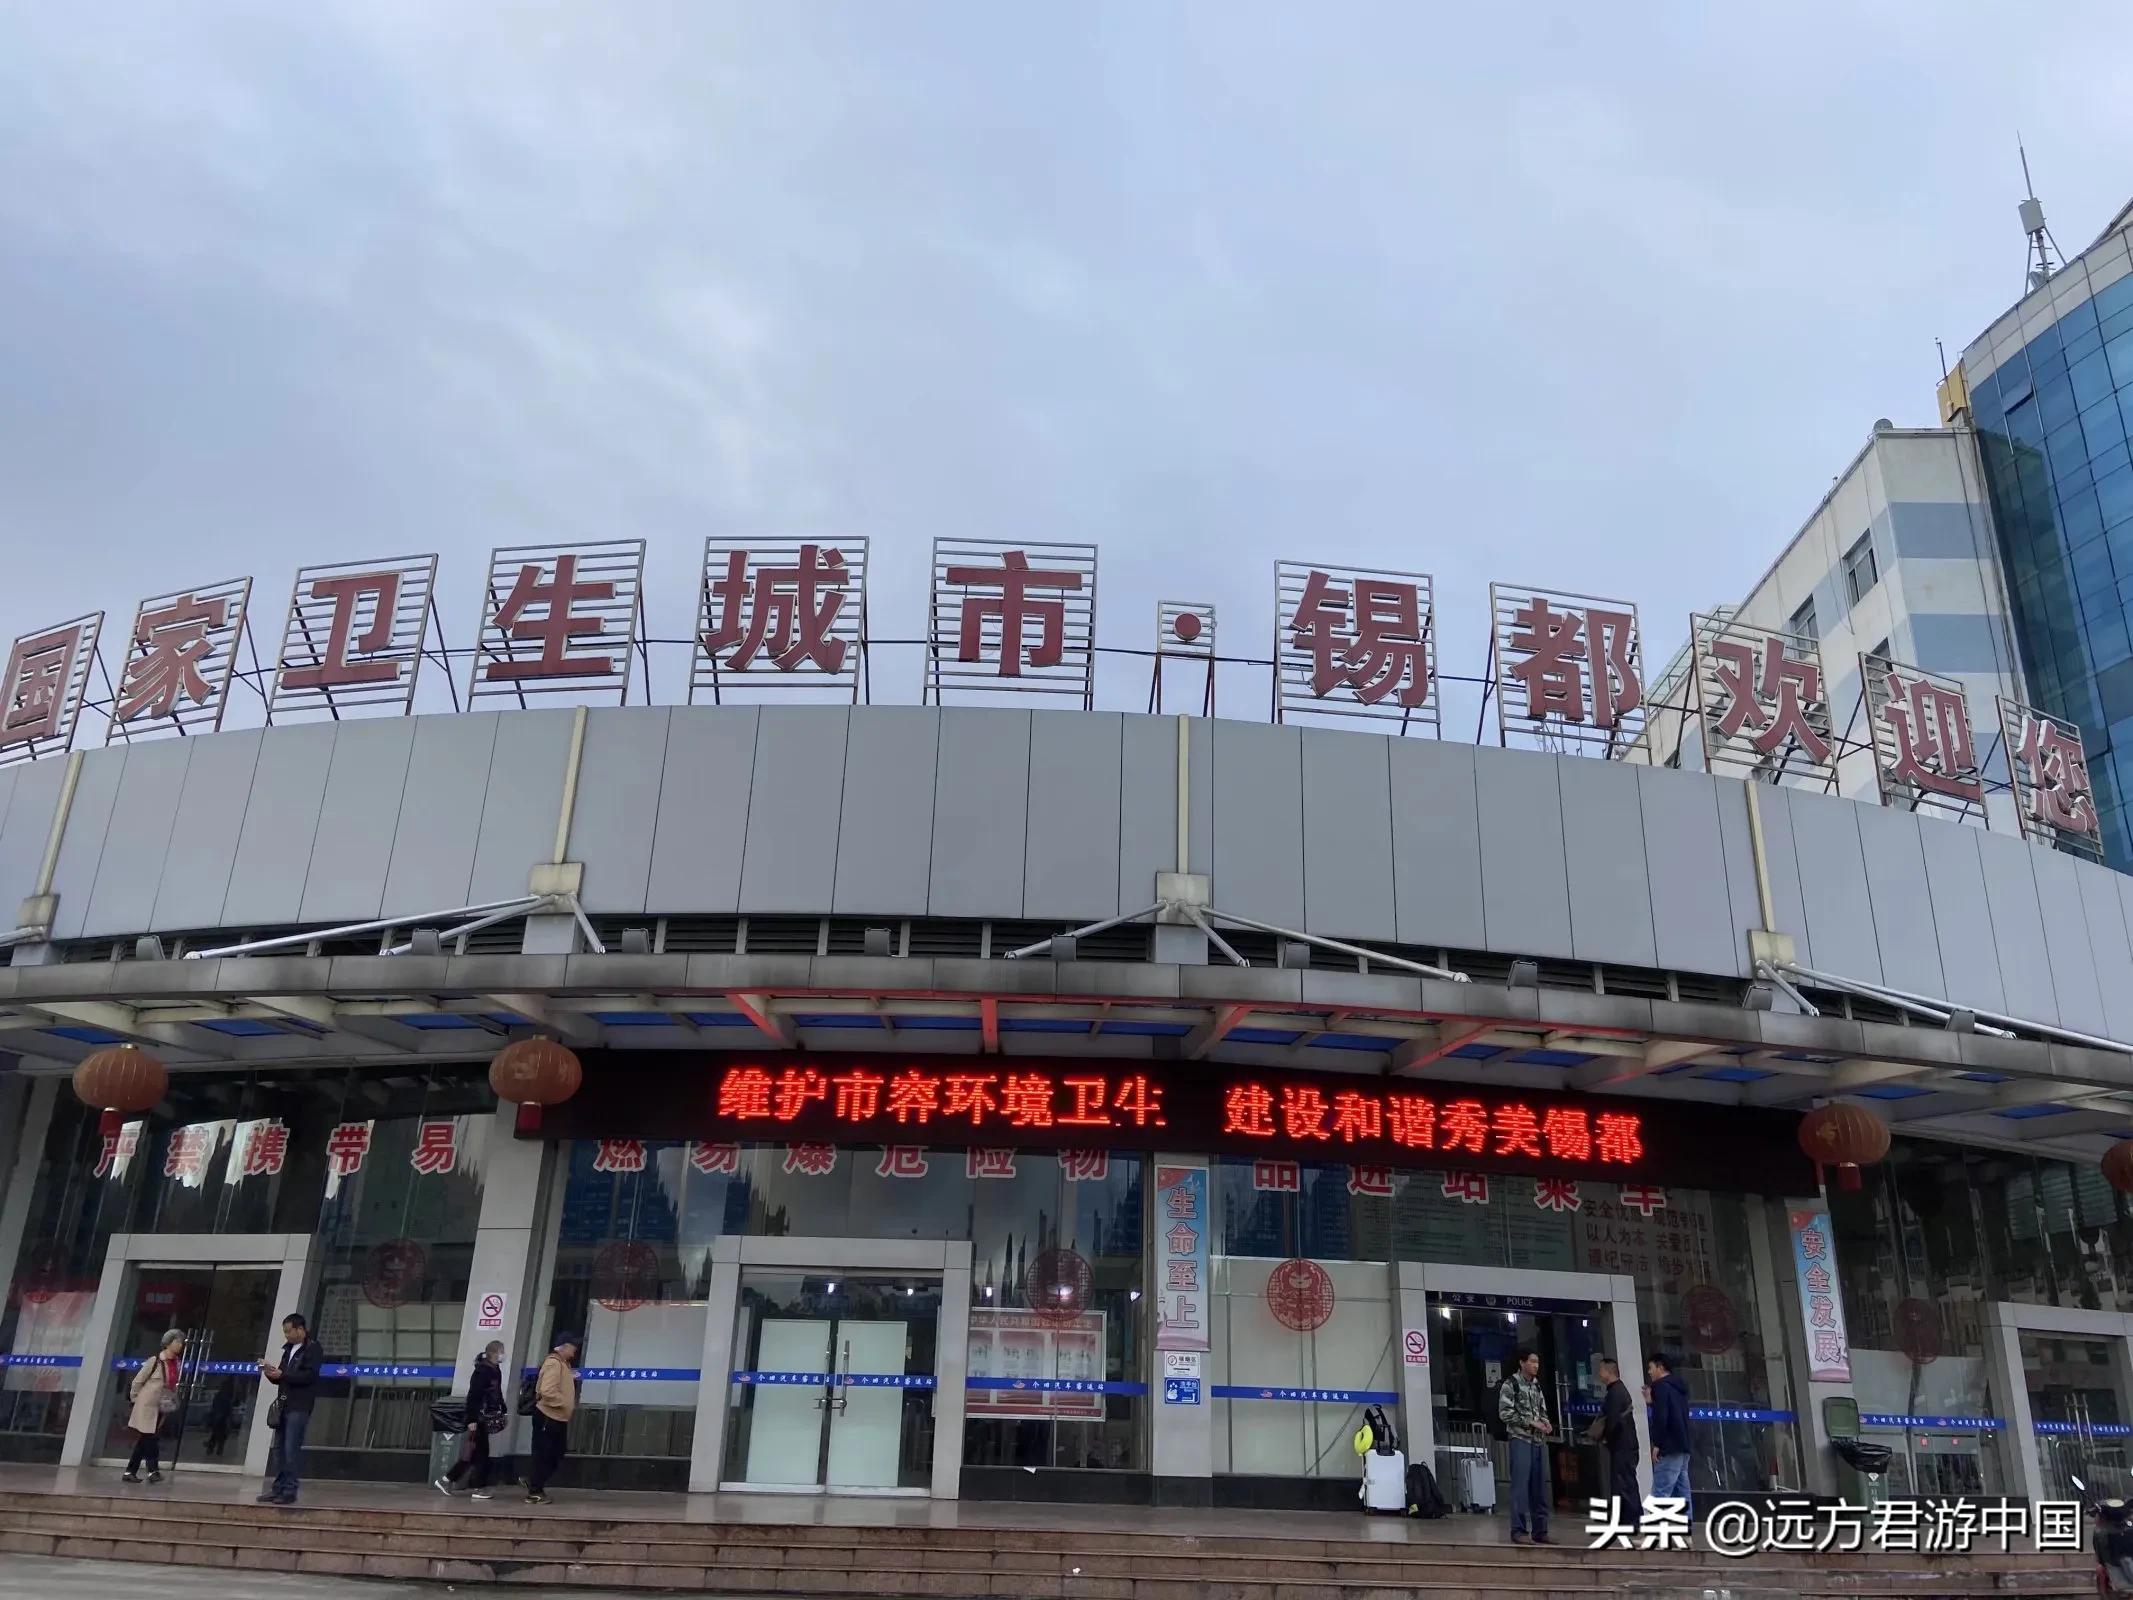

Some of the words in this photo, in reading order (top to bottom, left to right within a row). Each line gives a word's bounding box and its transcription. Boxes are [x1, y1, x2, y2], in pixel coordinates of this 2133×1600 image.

[93, 1121, 458, 1178] 严禁携带易
[718, 1068, 1167, 1128] 维护市容环境卫生
[1223, 1084, 1645, 1164] 建设和谐秀美锡都
[1165, 1186, 1200, 1330] 生命至上
[1506, 1296, 1534, 1307] POLICE
[1800, 1228, 1842, 1364] 安全发展
